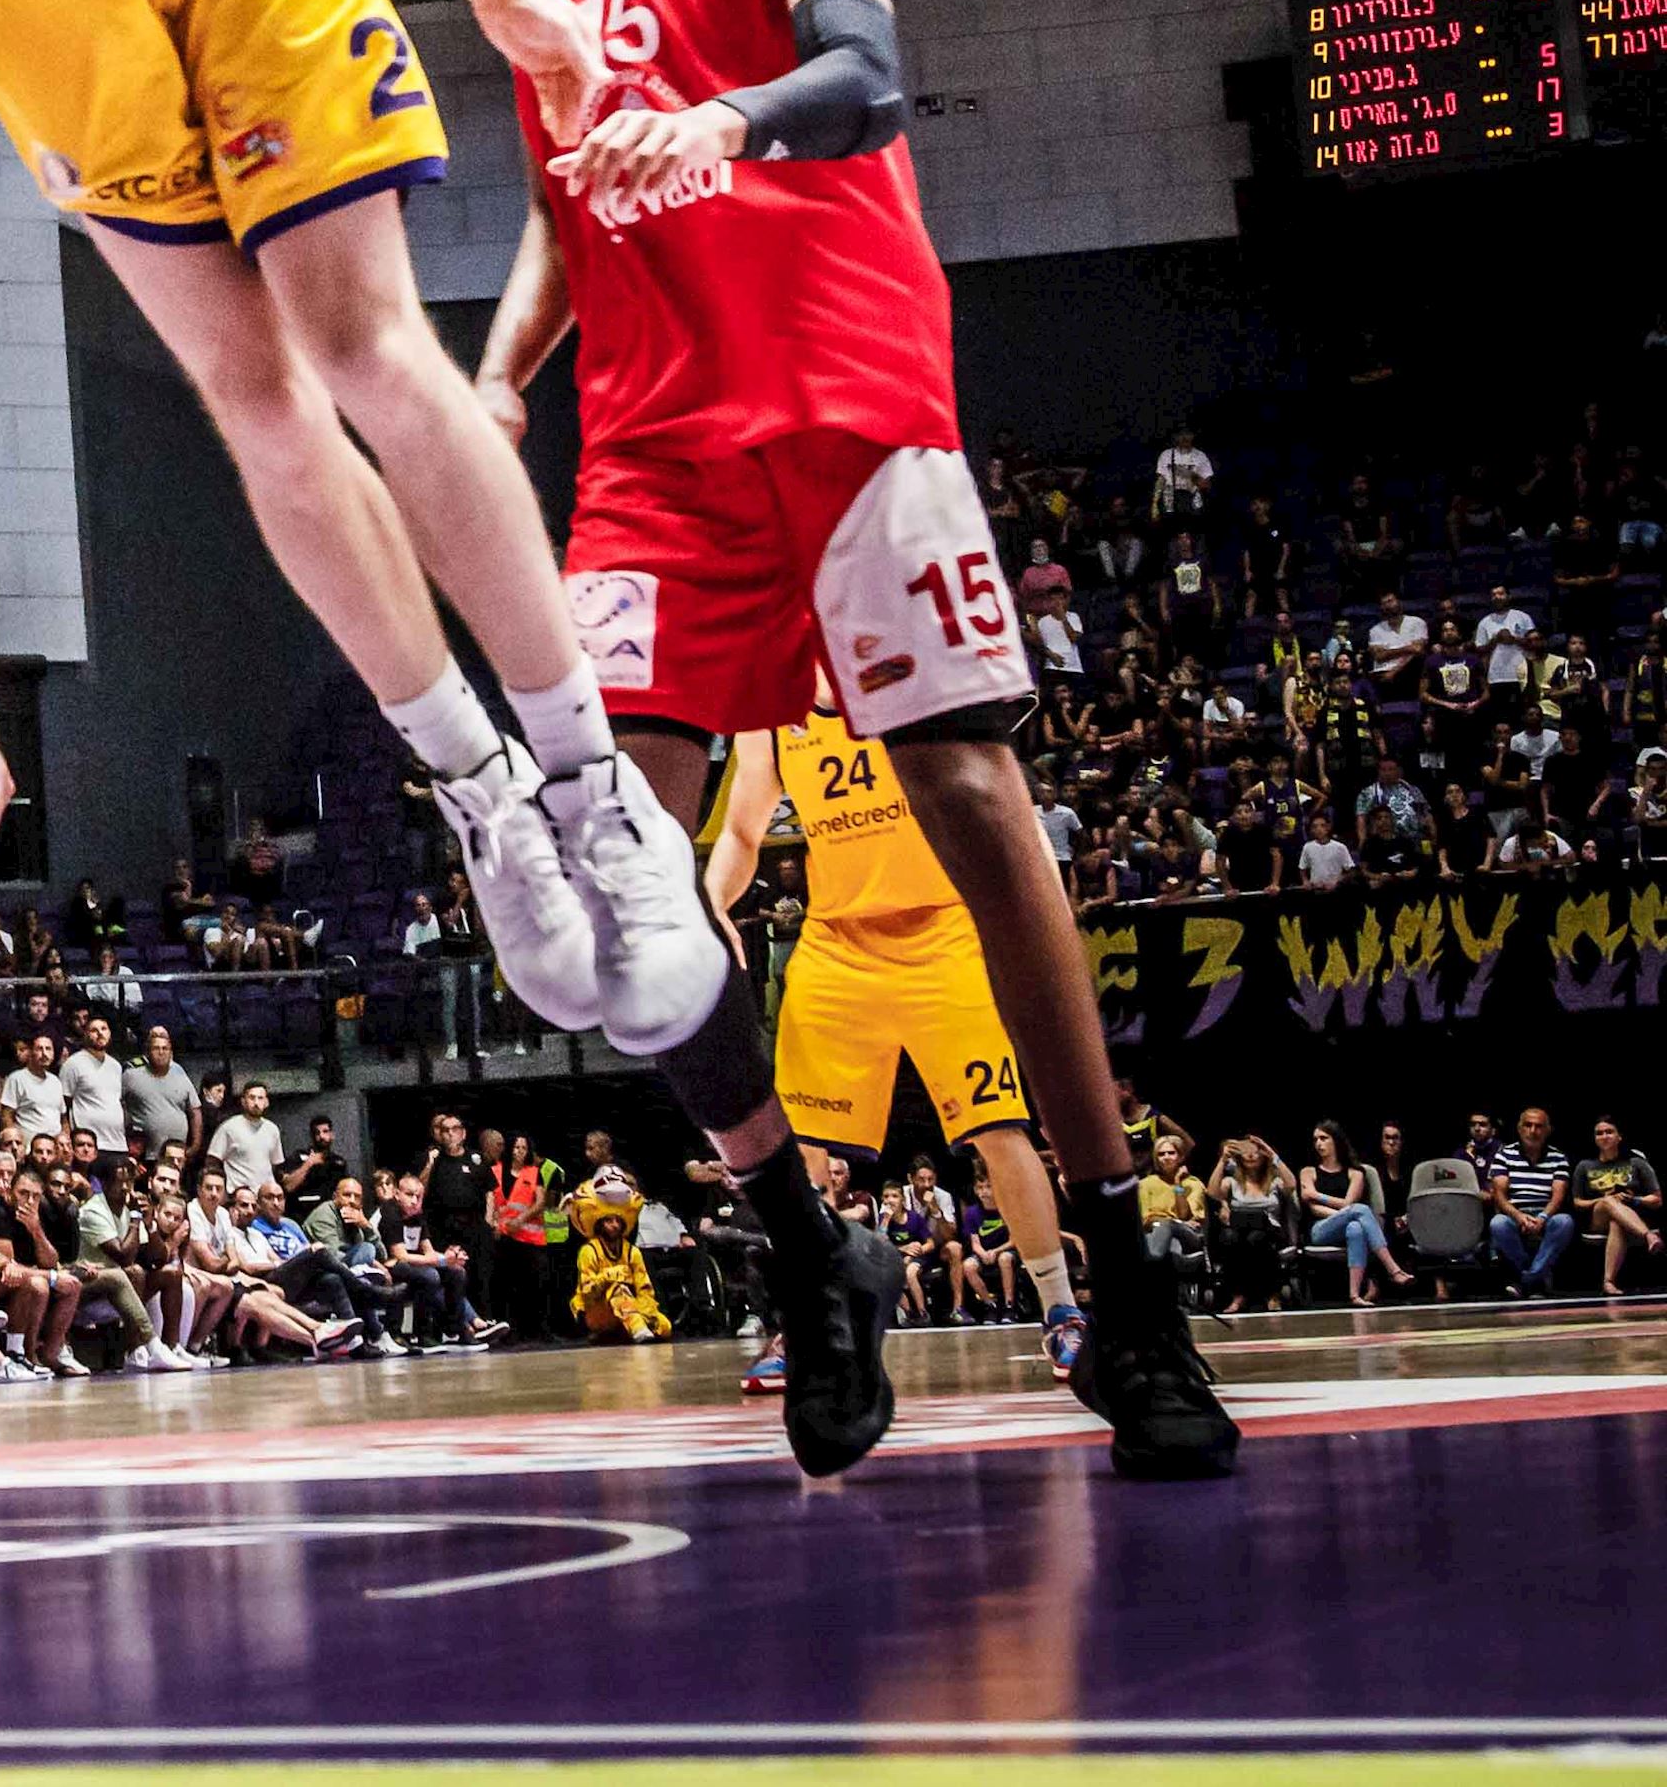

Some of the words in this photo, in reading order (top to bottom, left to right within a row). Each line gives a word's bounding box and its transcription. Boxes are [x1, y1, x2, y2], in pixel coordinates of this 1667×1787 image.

[1310, 8, 1325, 32] 8
[349, 16, 427, 120] 2
[1310, 75, 1333, 101] 10
[1540, 42, 1557, 68] 5
[1313, 41, 1328, 64] 9
[1585, 33, 1618, 59] 77
[1313, 110, 1336, 135] 11
[1536, 76, 1562, 103] 17
[1316, 143, 1340, 169] 14
[1548, 111, 1563, 137] 3
[905, 551, 1006, 647] 15
[818, 749, 877, 800] 24
[805, 799, 909, 838] unetcredi
[964, 1056, 1018, 1106] 24
